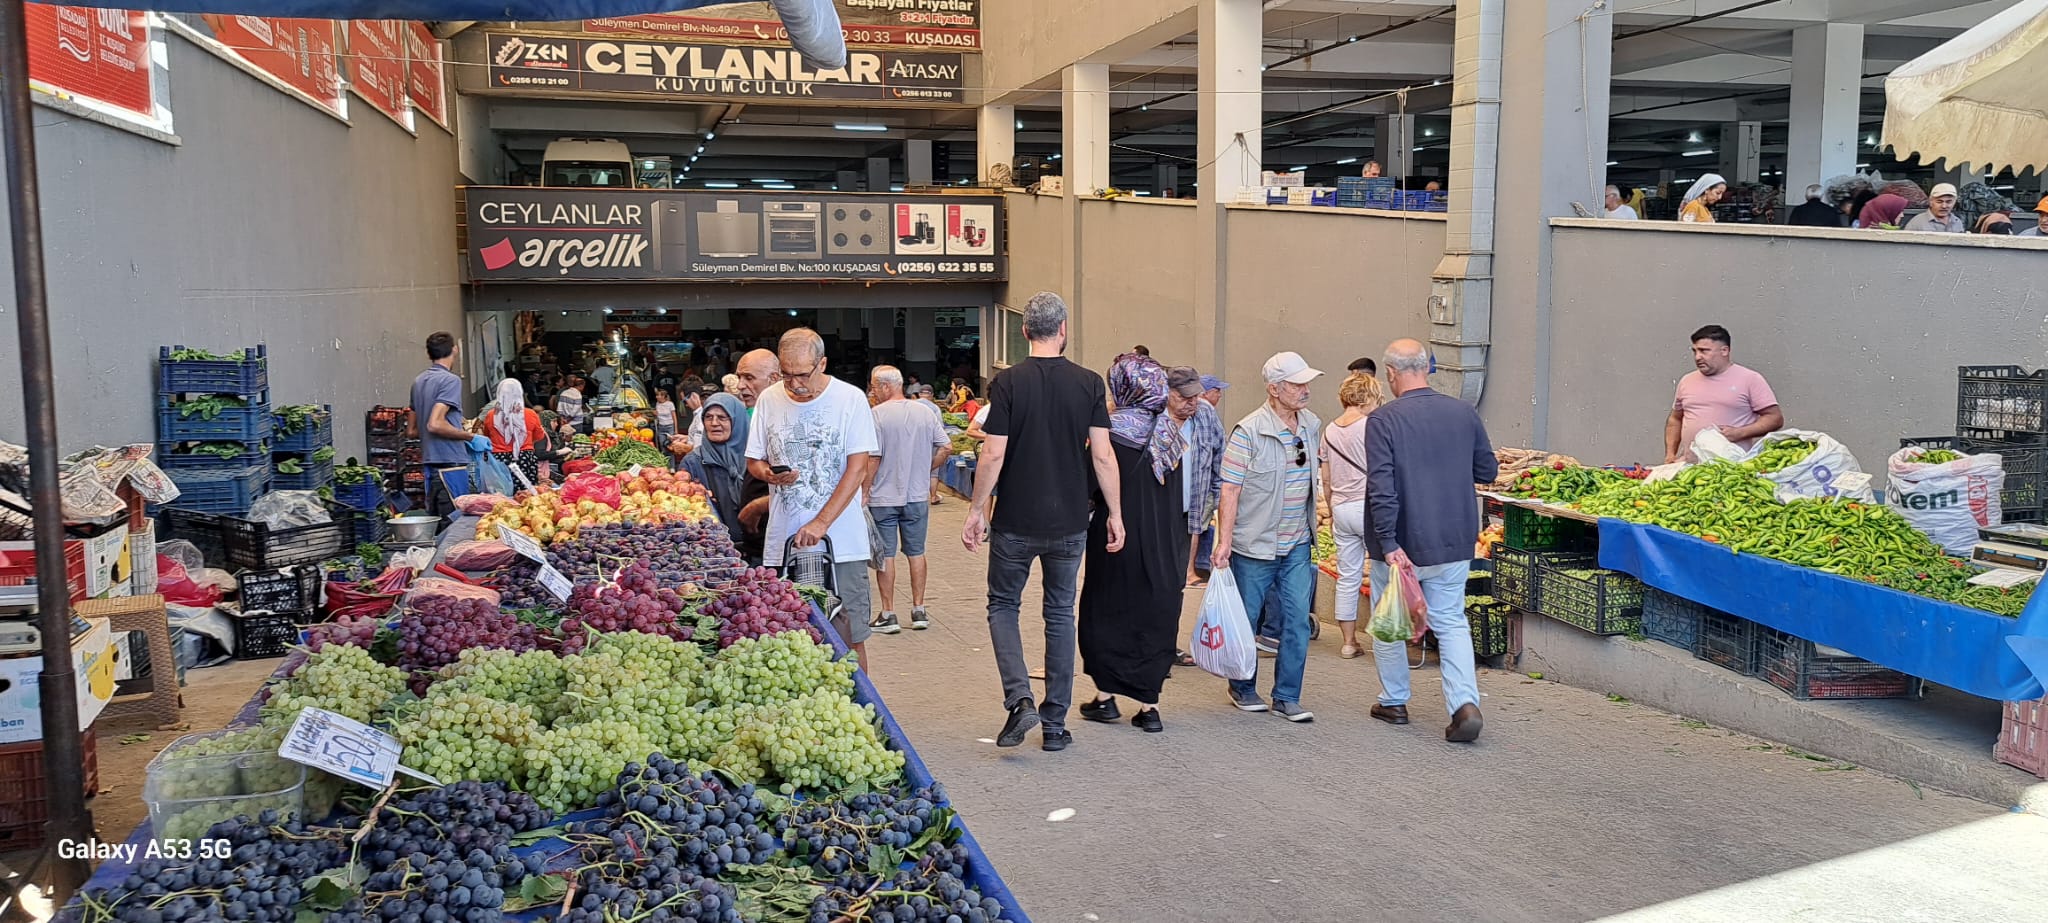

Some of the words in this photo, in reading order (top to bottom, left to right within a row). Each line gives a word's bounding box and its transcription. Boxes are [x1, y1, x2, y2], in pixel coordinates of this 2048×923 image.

[642, 20, 680, 31] Demirel
[900, 12, 931, 23] 3+2+1
[932, 13, 974, 25] Fiyatıdır
[853, 30, 870, 42] 30
[874, 31, 890, 43] 33
[905, 32, 975, 47] KUŞADASI
[524, 42, 568, 61] ZEN
[889, 59, 958, 79] ATASAY
[510, 76, 531, 85] 0256
[655, 77, 813, 96] KUYUMCULUK
[479, 202, 642, 225] CEYLANLAR
[518, 233, 649, 275] arçelik
[692, 262, 739, 274] Süleyman
[741, 263, 778, 272] Demirel
[780, 263, 796, 272] Blv.
[798, 263, 830, 273] No:100
[832, 263, 881, 275] KUŞADASI
[897, 262, 935, 274] (0256)
[938, 262, 960, 273] 622
[962, 262, 977, 273] 35
[979, 262, 994, 273] 55
